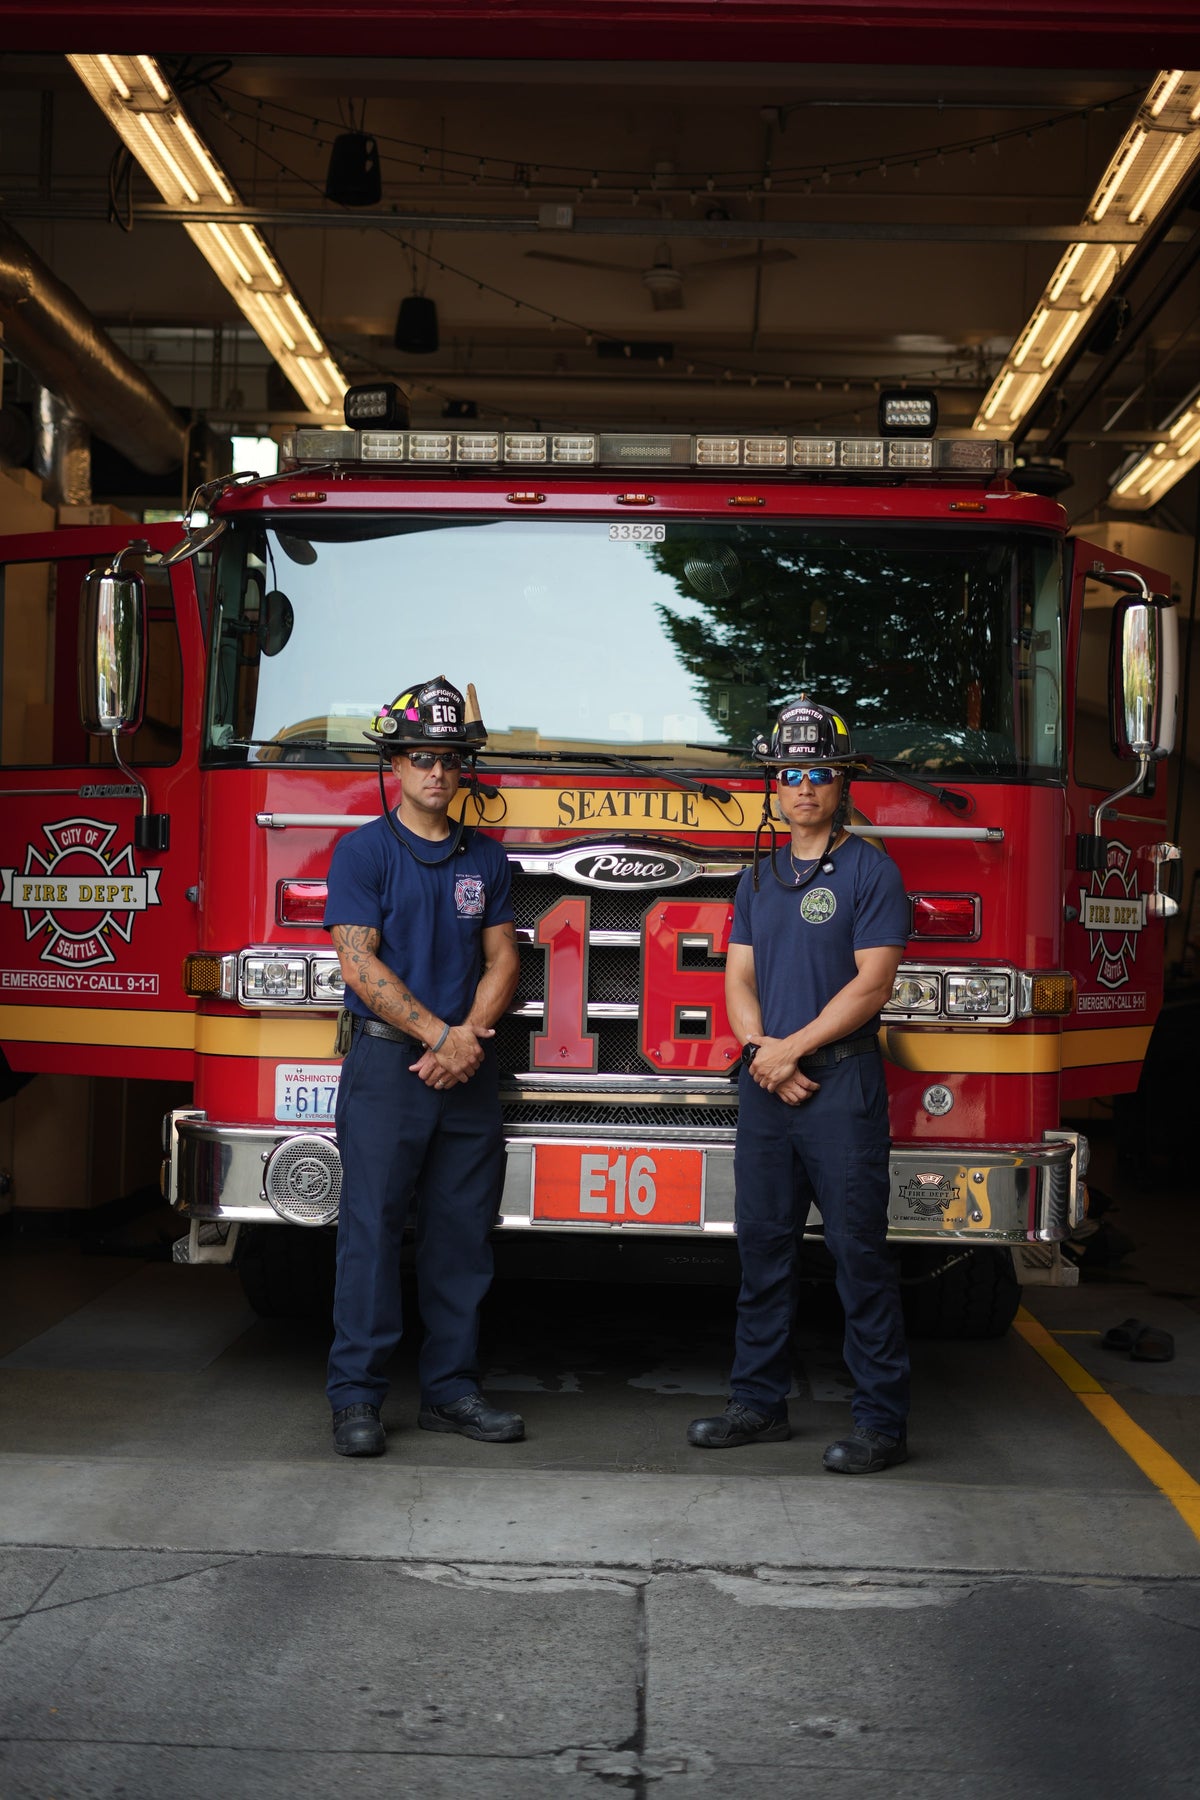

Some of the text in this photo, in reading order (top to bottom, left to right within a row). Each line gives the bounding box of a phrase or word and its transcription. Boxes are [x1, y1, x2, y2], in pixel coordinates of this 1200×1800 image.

[609, 525, 664, 540] 33526
[423, 689, 461, 703] FIREFIGHTER
[432, 705, 457, 723] E16
[782, 708, 824, 721] FIREFIGHTER
[800, 725, 817, 741] 16
[788, 746, 816, 754] SEATTLE
[557, 790, 700, 828] SEATTLE
[61, 828, 99, 846] CITY OF
[588, 855, 667, 879] Pierce
[1107, 850, 1125, 867] CITY OF
[23, 884, 138, 903] FIRE DEPT.
[1089, 905, 1139, 925] FIRE DEPT.
[57, 939, 98, 959] SEATTLE
[1103, 961, 1122, 980] SEATTLE
[1, 973, 155, 991] EMERGENCY-CALL 9-1-1
[529, 895, 742, 1077] 16
[296, 1086, 336, 1113] 617
[579, 1153, 657, 1216] E16
